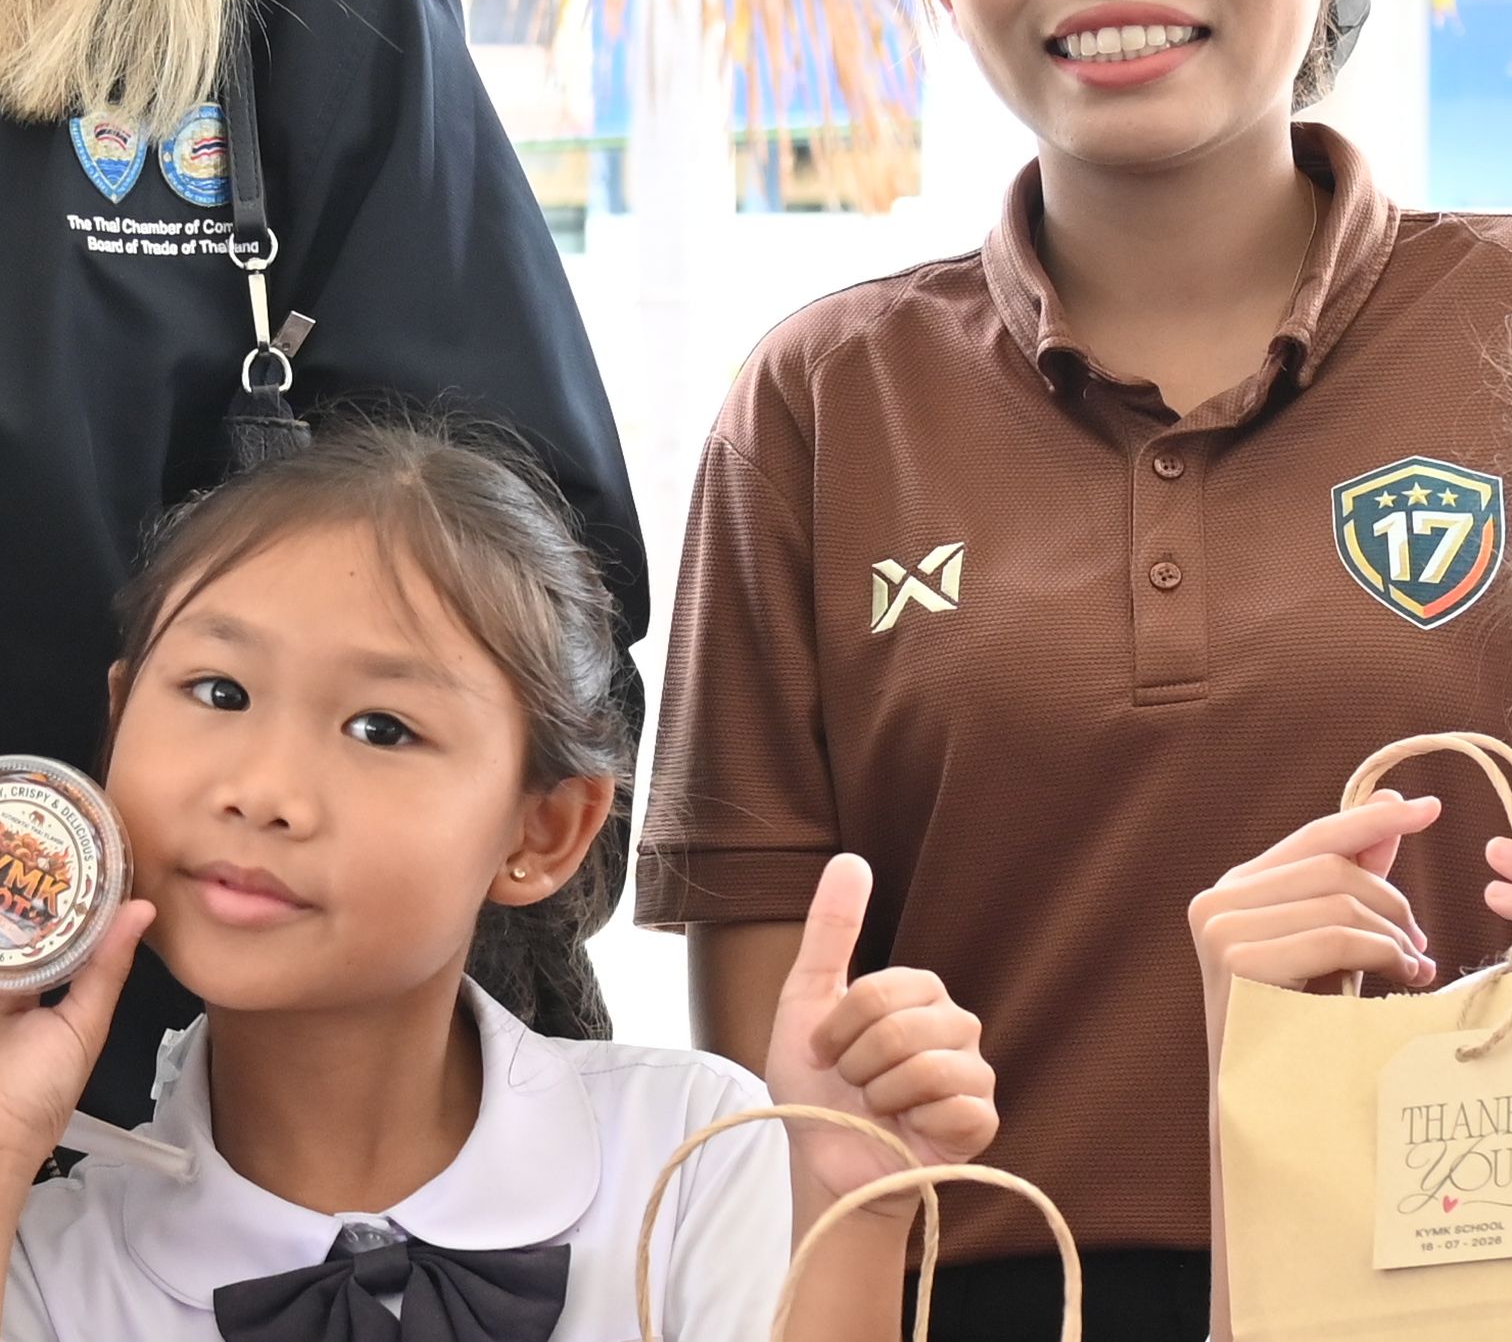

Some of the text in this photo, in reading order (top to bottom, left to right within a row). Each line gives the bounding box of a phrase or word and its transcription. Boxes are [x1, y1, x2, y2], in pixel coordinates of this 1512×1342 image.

[66, 214, 233, 235] The Thai Chamber of Com
[87, 236, 259, 255] Board of Trade of Thaiand
[1372, 510, 1474, 584] 17
[10, 785, 51, 803] CRISPY
[51, 799, 60, 809] &
[60, 806, 94, 862] DELICIOUS
[1415, 1221, 1505, 1238] KYMK SCHOOL
[1444, 1240, 1460, 1249] 07
